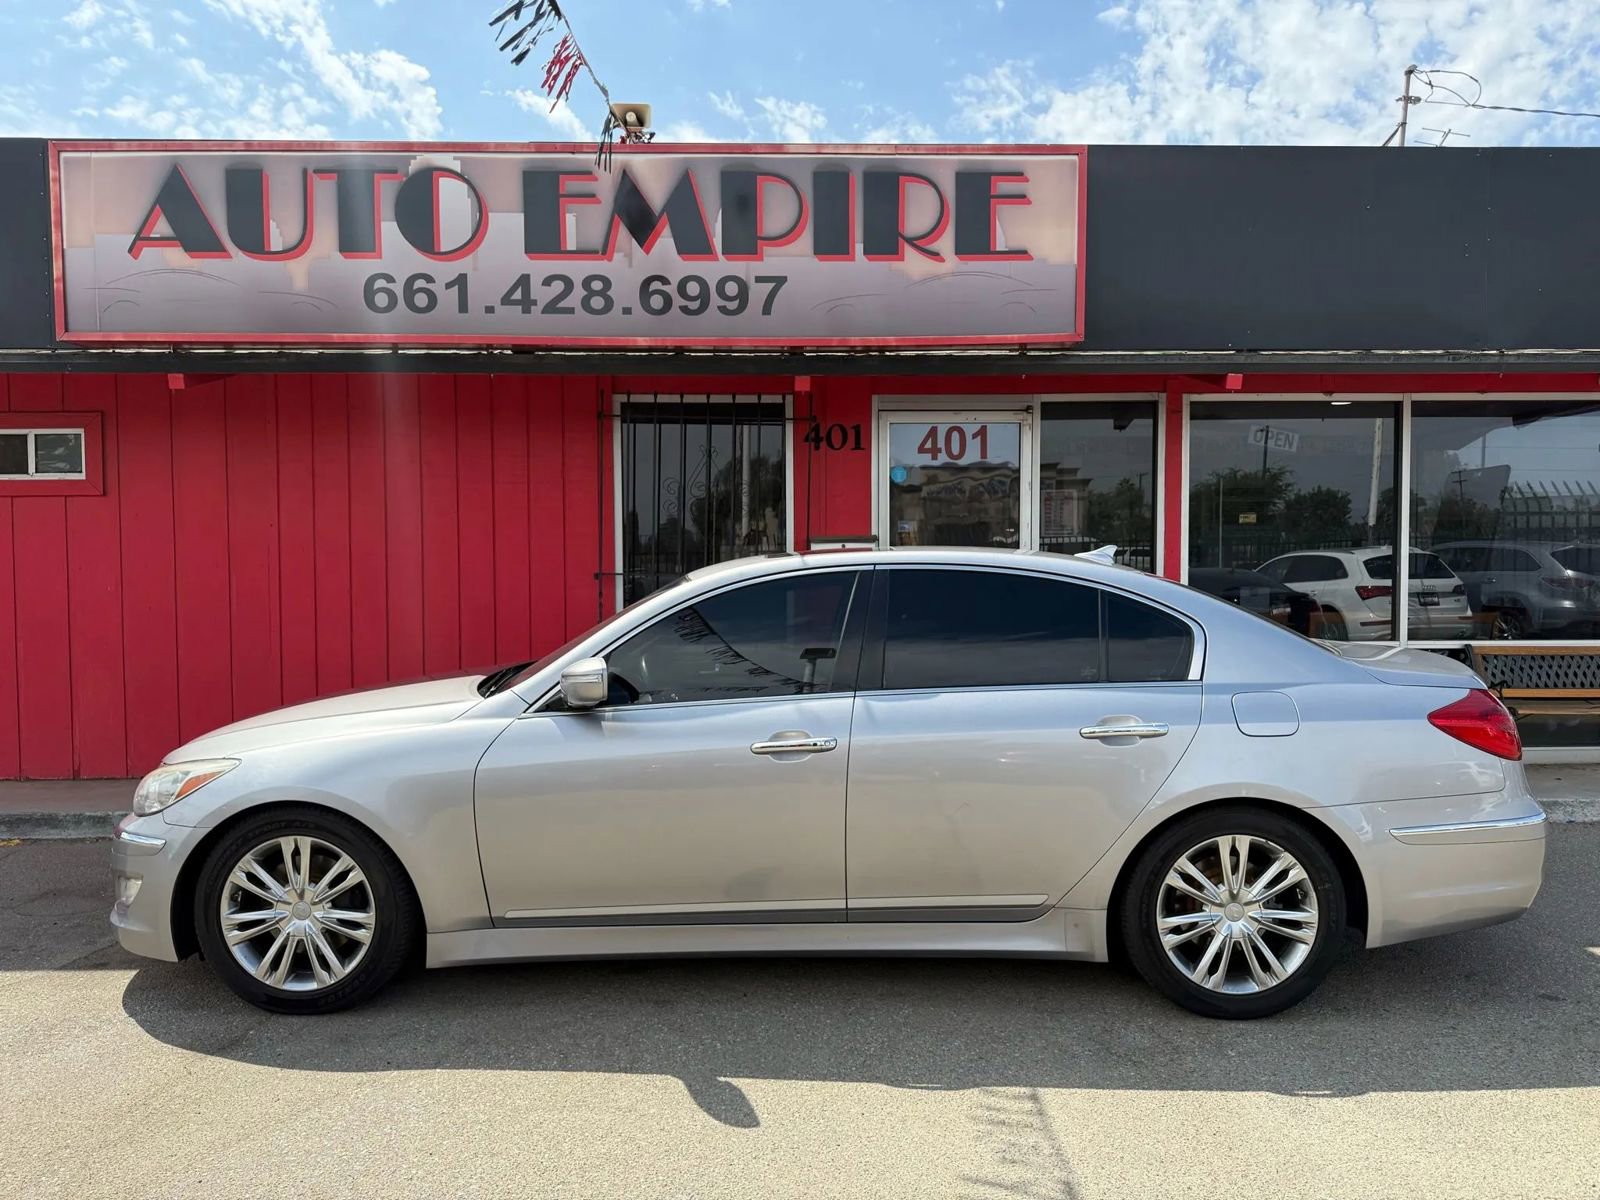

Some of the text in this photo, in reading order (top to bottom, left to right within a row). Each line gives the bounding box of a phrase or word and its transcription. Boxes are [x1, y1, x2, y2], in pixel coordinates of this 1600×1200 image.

[127, 164, 1034, 262] AUTO EMPIRE
[363, 272, 788, 316] 661.428.6997
[804, 422, 865, 451] 401
[917, 425, 988, 461] 401
[1253, 429, 1295, 450] OPEN
